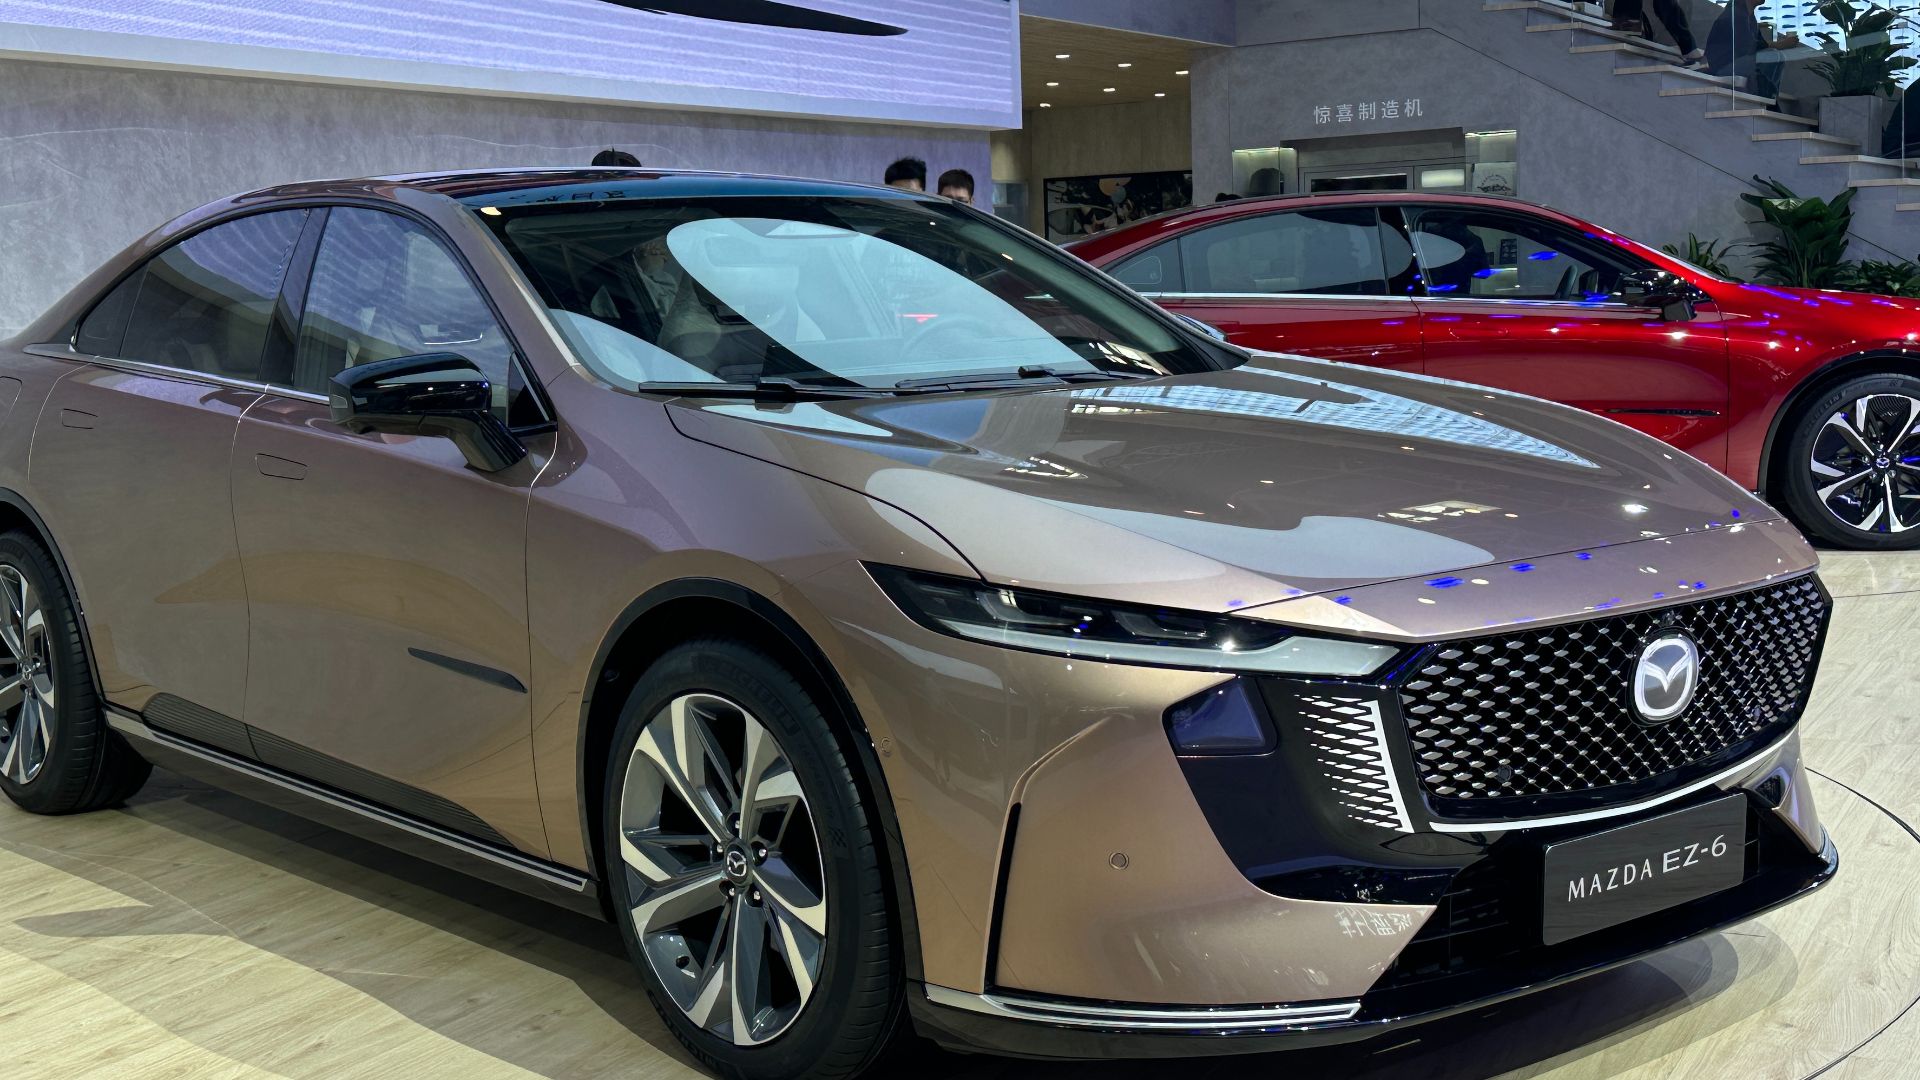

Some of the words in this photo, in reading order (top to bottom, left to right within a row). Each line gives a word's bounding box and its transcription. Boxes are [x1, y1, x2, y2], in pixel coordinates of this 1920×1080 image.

[1313, 98, 1423, 125] 惊喜制造机
[1567, 858, 1653, 903] MAZDA
[1662, 834, 1728, 874] EZ-6
